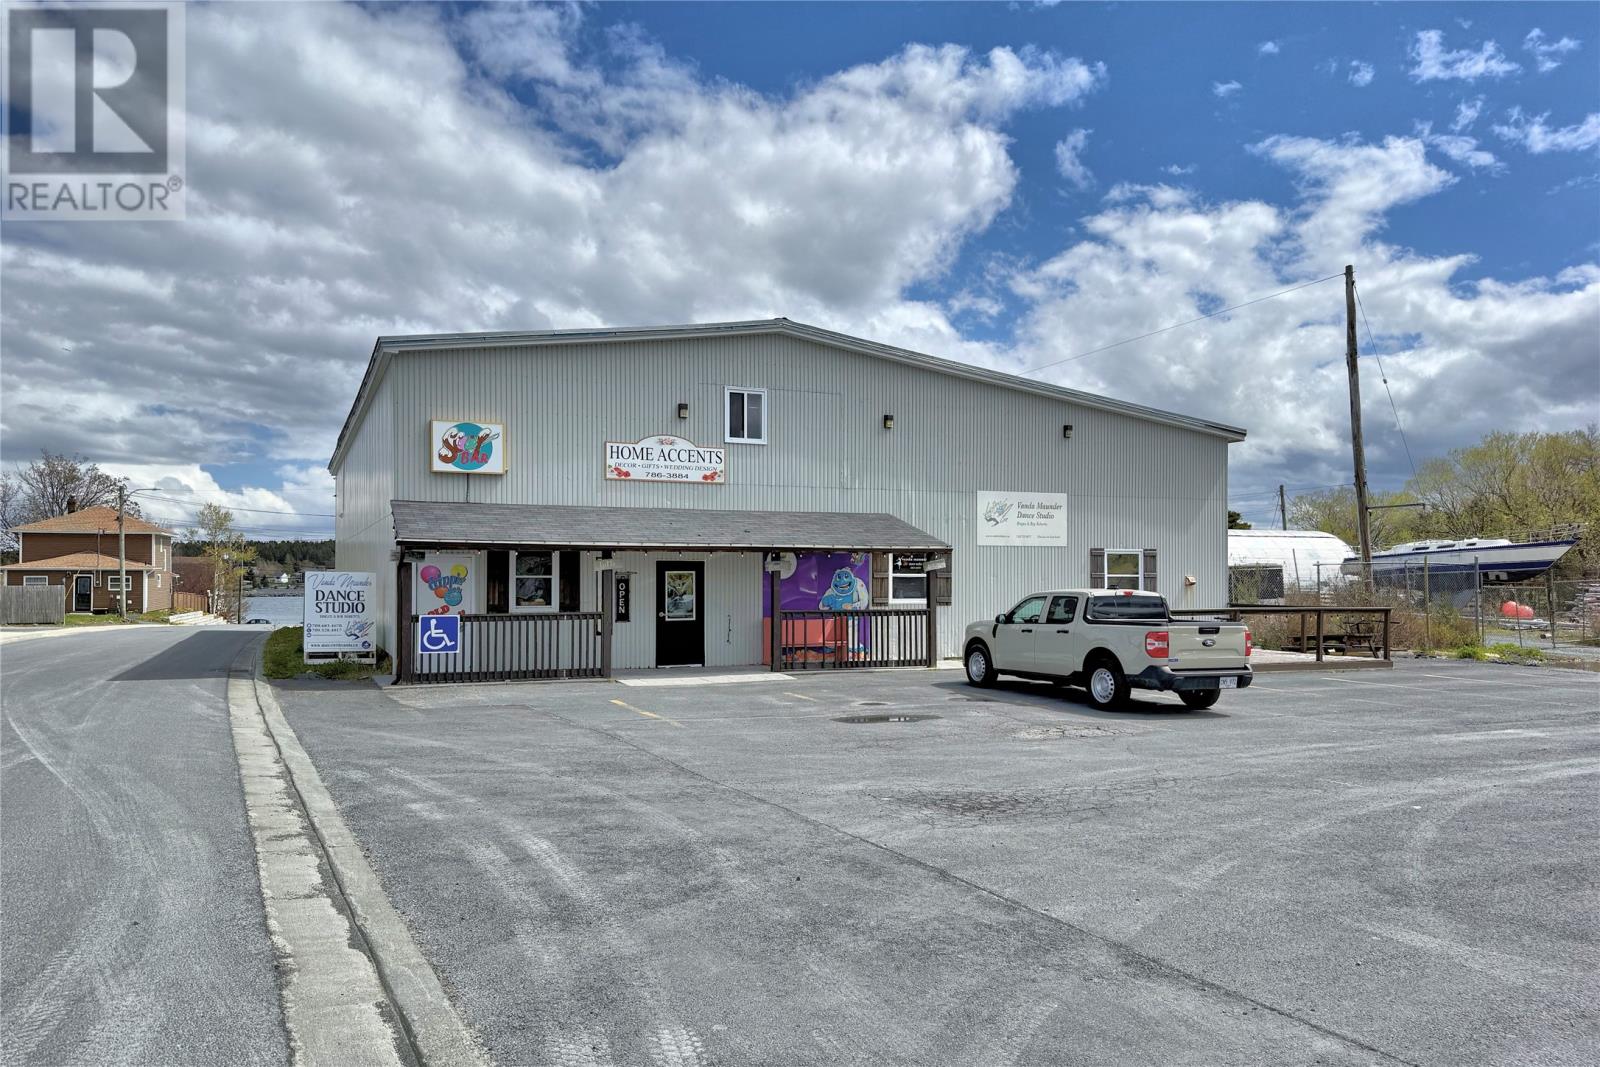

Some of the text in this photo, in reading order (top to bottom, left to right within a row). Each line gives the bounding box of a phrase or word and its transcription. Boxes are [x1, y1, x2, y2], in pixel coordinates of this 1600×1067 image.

[610, 445, 723, 465] HOME ACCENTS
[694, 465, 718, 473] DESIGN
[1016, 511, 1055, 520] Dance Studio
[315, 589, 365, 602] DANCE
[618, 582, 626, 614] OPEN
[315, 601, 366, 614] STUDIO
